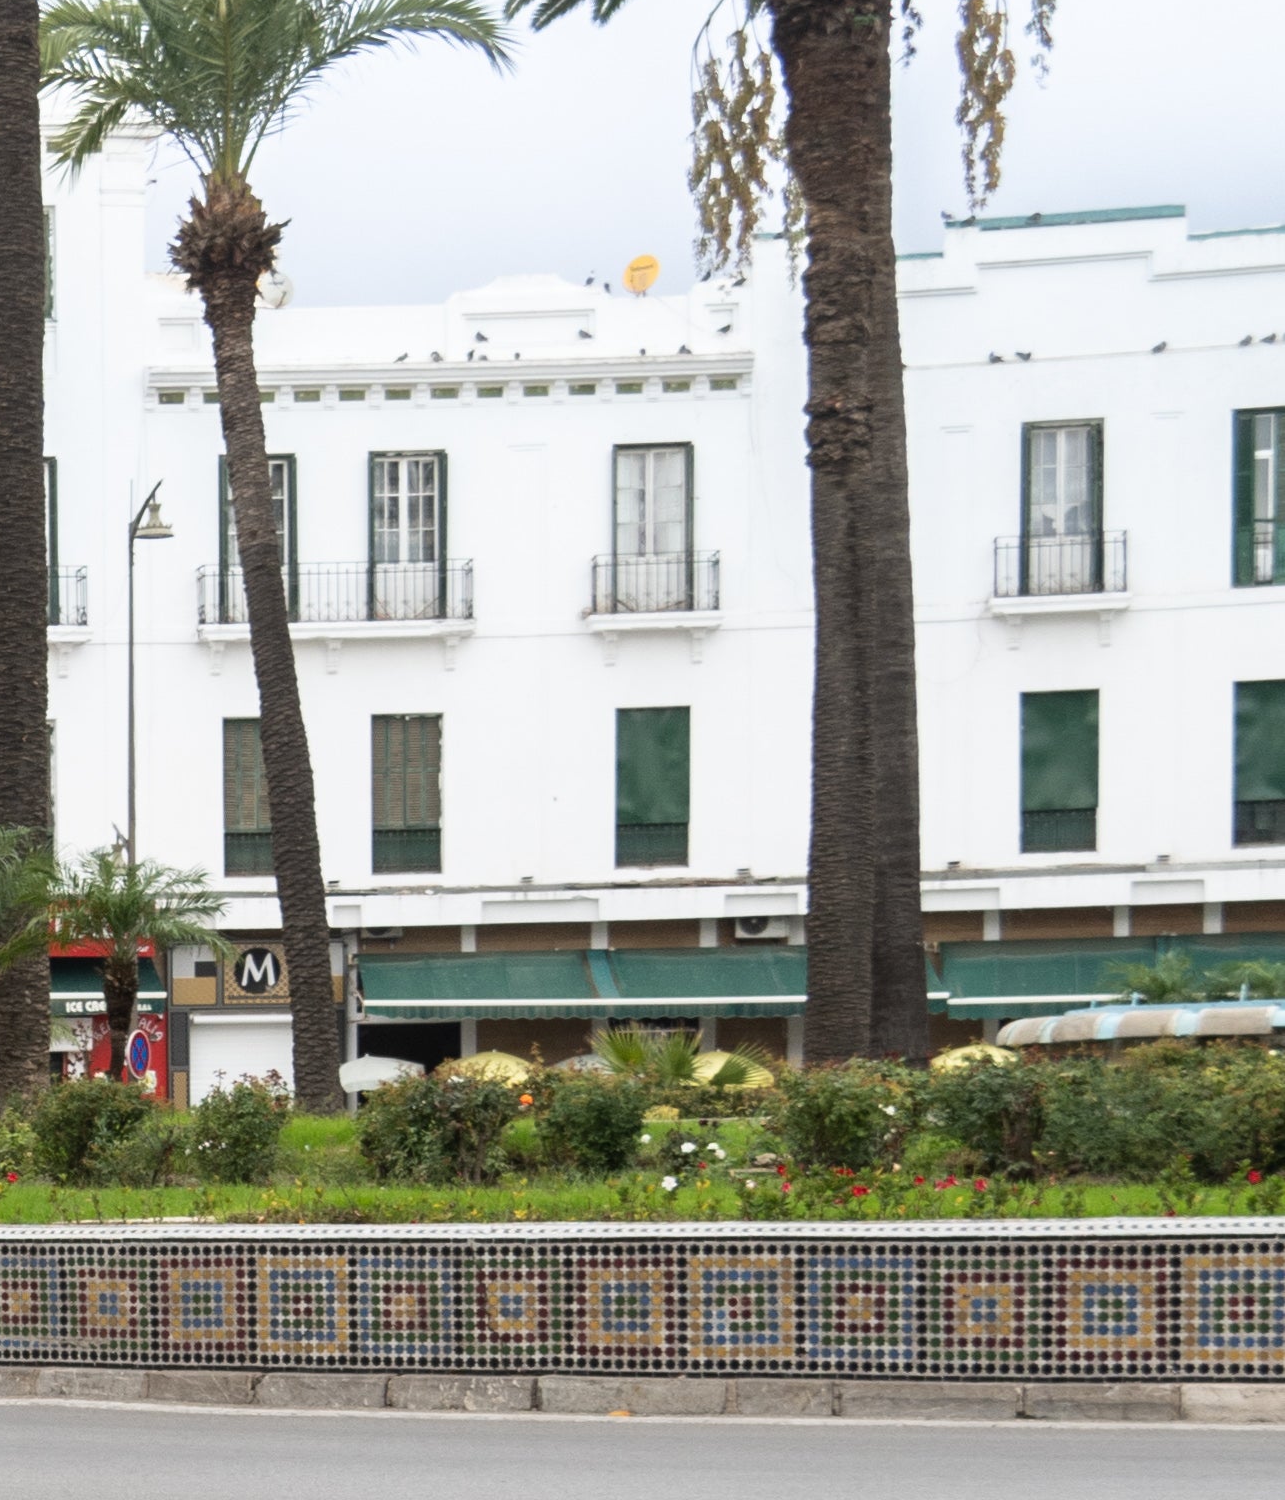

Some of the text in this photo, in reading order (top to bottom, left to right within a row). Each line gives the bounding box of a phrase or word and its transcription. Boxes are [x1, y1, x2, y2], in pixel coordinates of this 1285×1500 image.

[241, 952, 276, 987] M
[65, 1000, 108, 1013] ICE CRE
